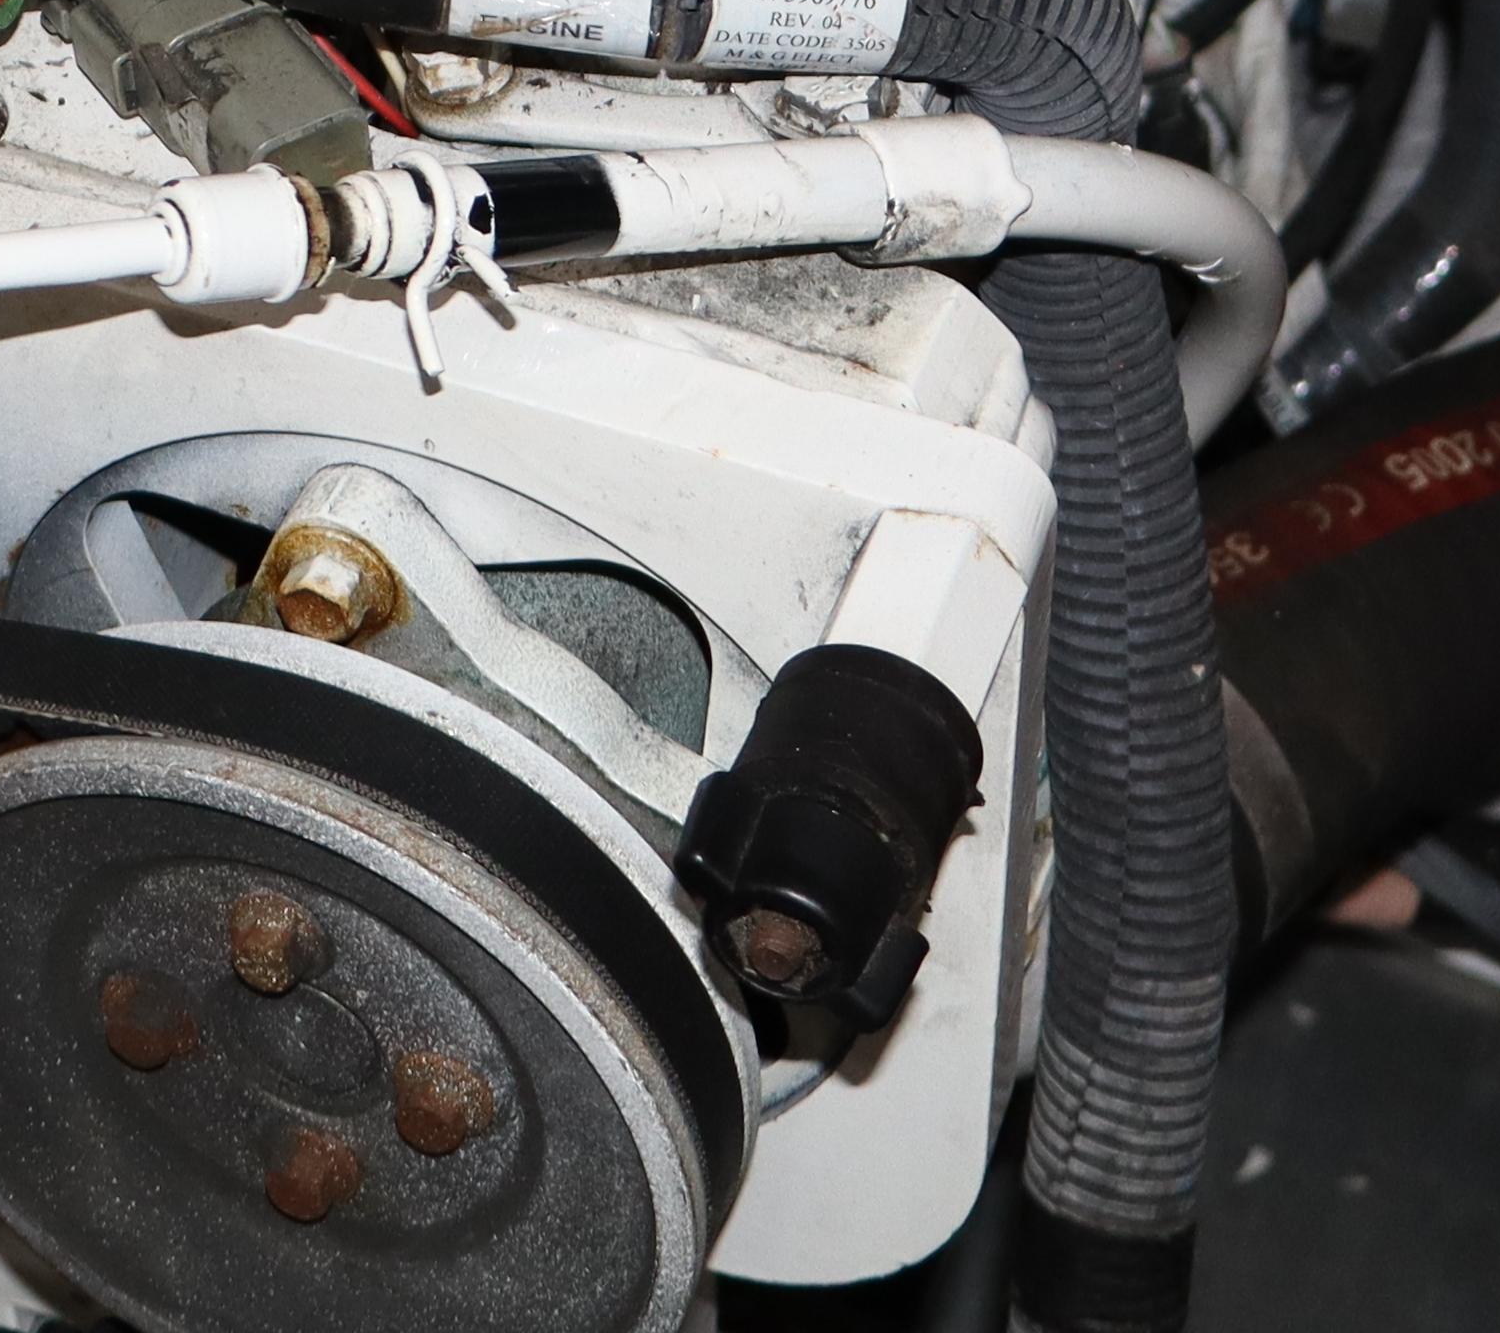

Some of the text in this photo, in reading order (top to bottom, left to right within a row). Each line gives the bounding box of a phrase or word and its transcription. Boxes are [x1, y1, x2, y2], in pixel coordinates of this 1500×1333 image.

[769, 11, 843, 31] REV. 04
[713, 30, 772, 47] DATE
[842, 37, 887, 53] 3505
